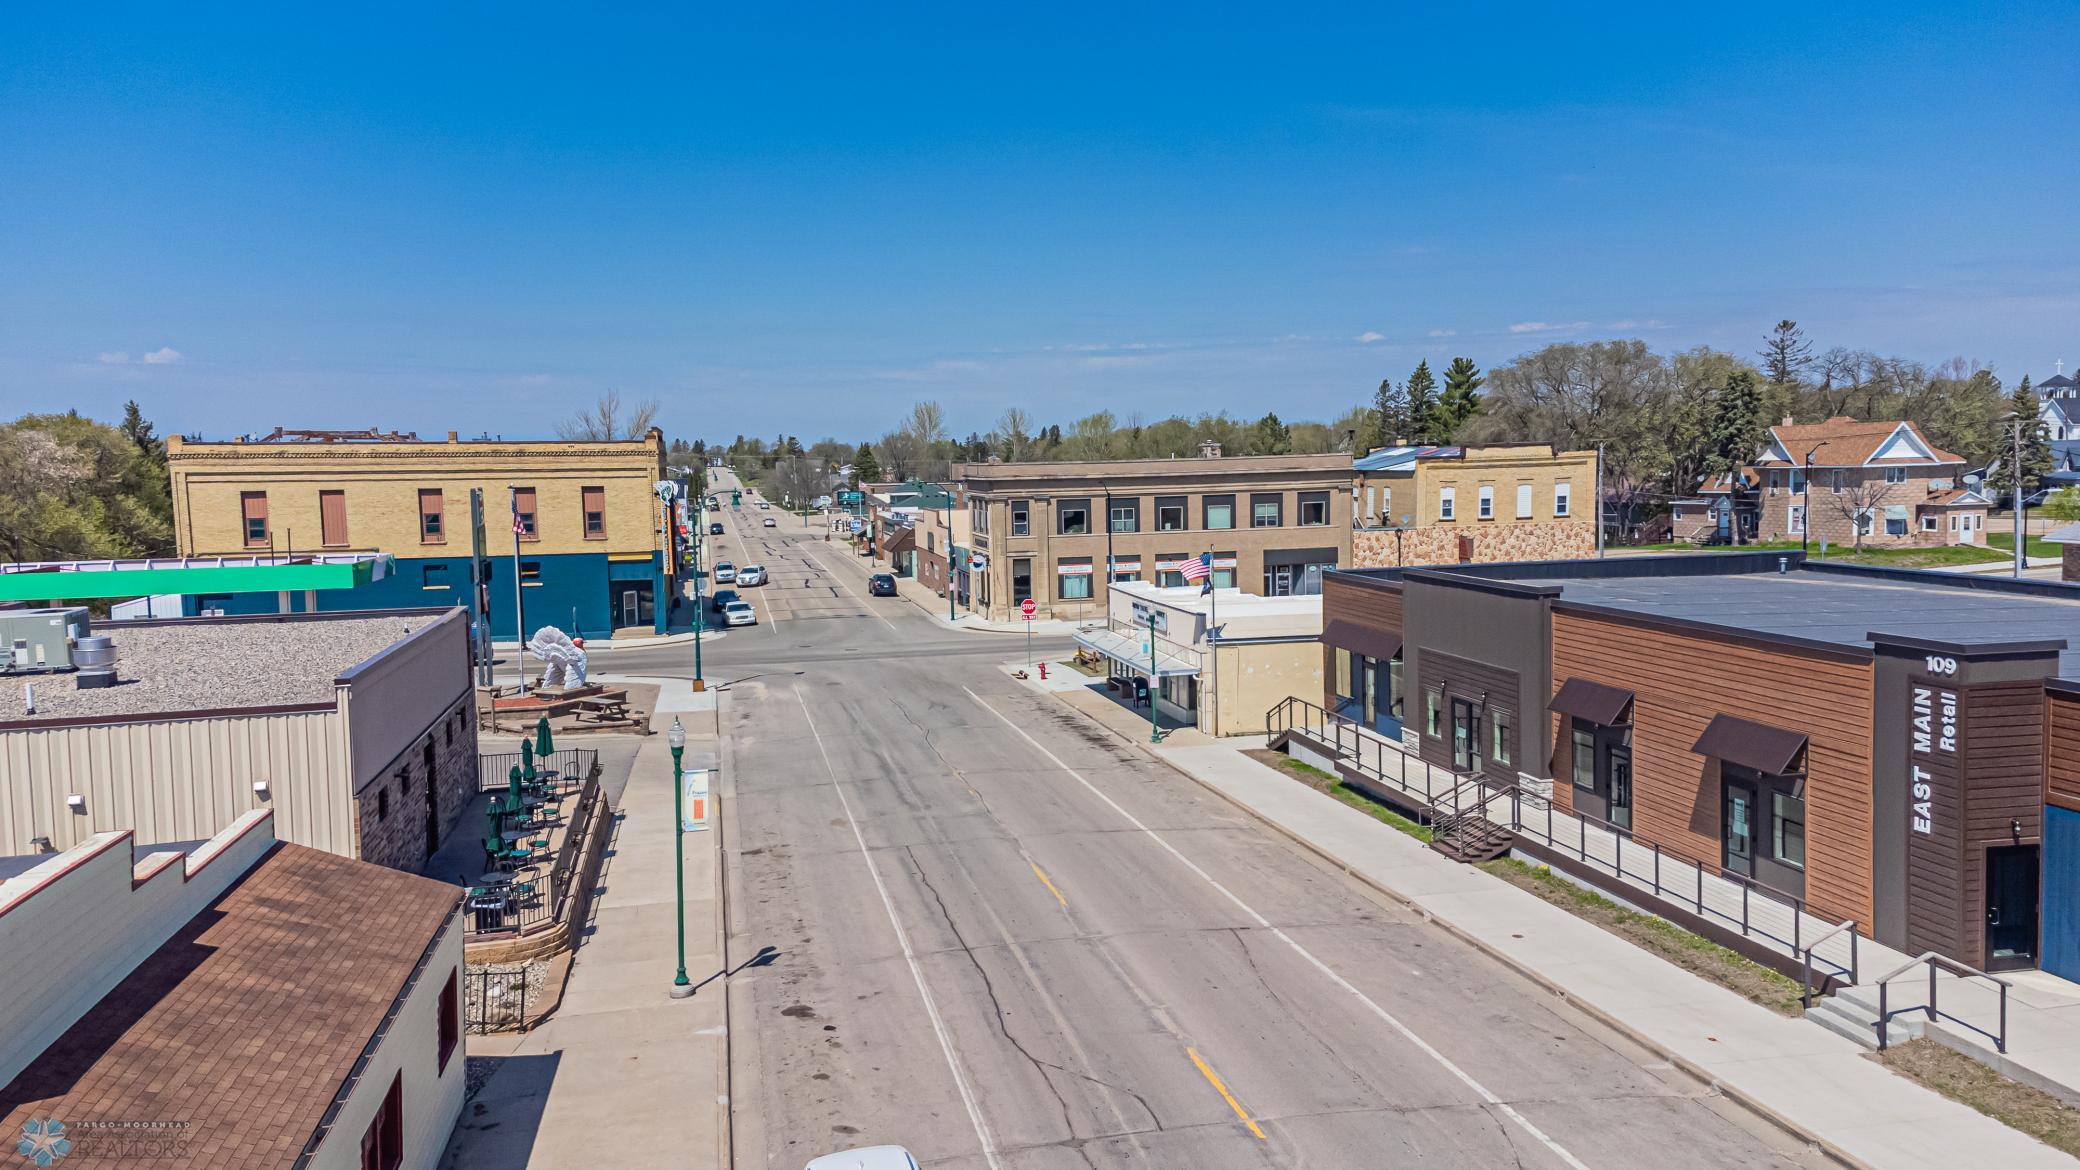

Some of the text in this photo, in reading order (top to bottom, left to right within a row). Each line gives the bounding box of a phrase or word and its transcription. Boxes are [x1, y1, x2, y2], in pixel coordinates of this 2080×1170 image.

[1925, 655, 1957, 675] 109
[1939, 692, 1957, 752] Retail
[1913, 688, 1932, 834] EAST MAIN
